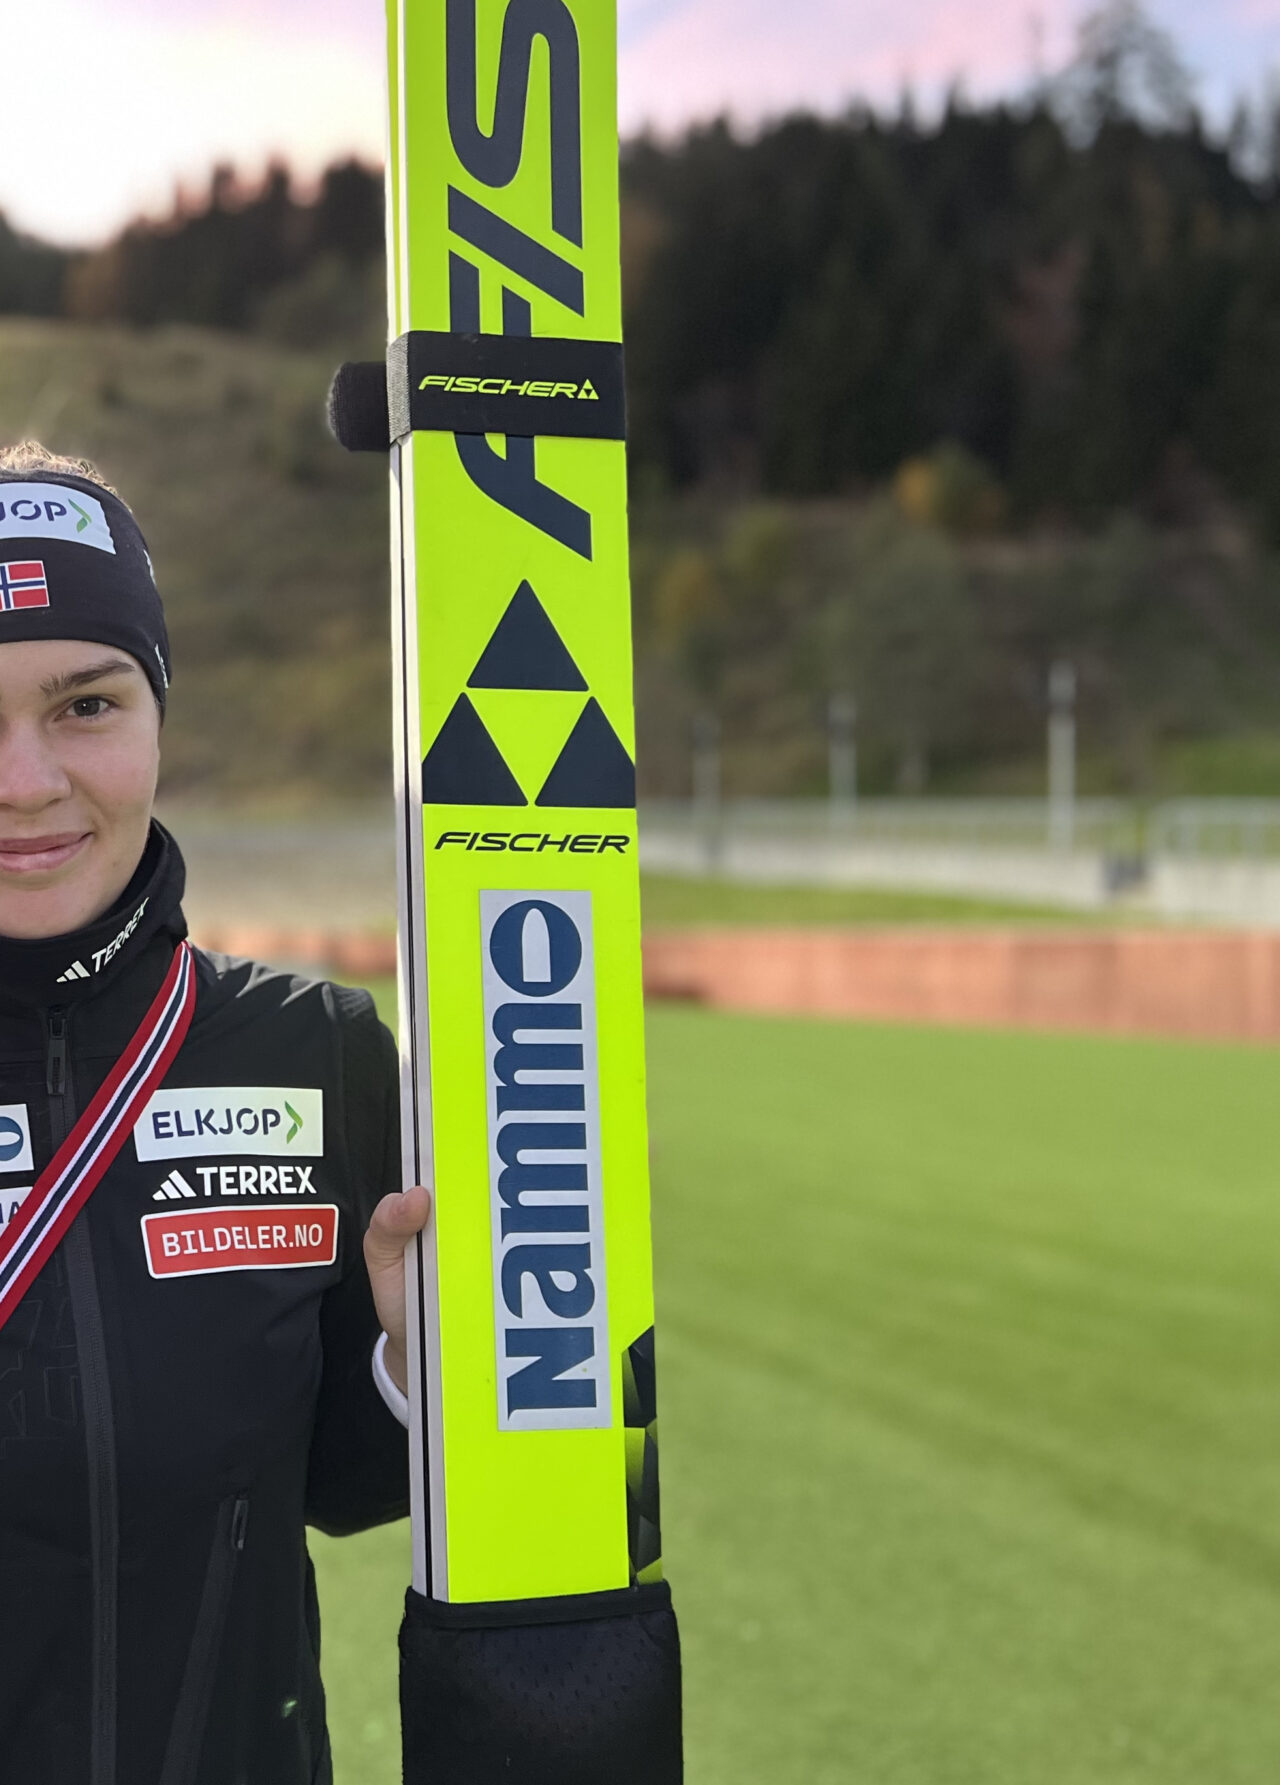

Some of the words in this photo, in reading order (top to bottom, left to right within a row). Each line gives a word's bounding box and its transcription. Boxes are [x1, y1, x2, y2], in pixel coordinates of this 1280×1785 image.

[419, 374, 577, 399] FISCHER
[433, 831, 630, 855] FISCHER
[91, 896, 150, 973] TERREX
[196, 1165, 317, 1196] TERREX
[161, 1223, 323, 1257] BILDELER.NO
